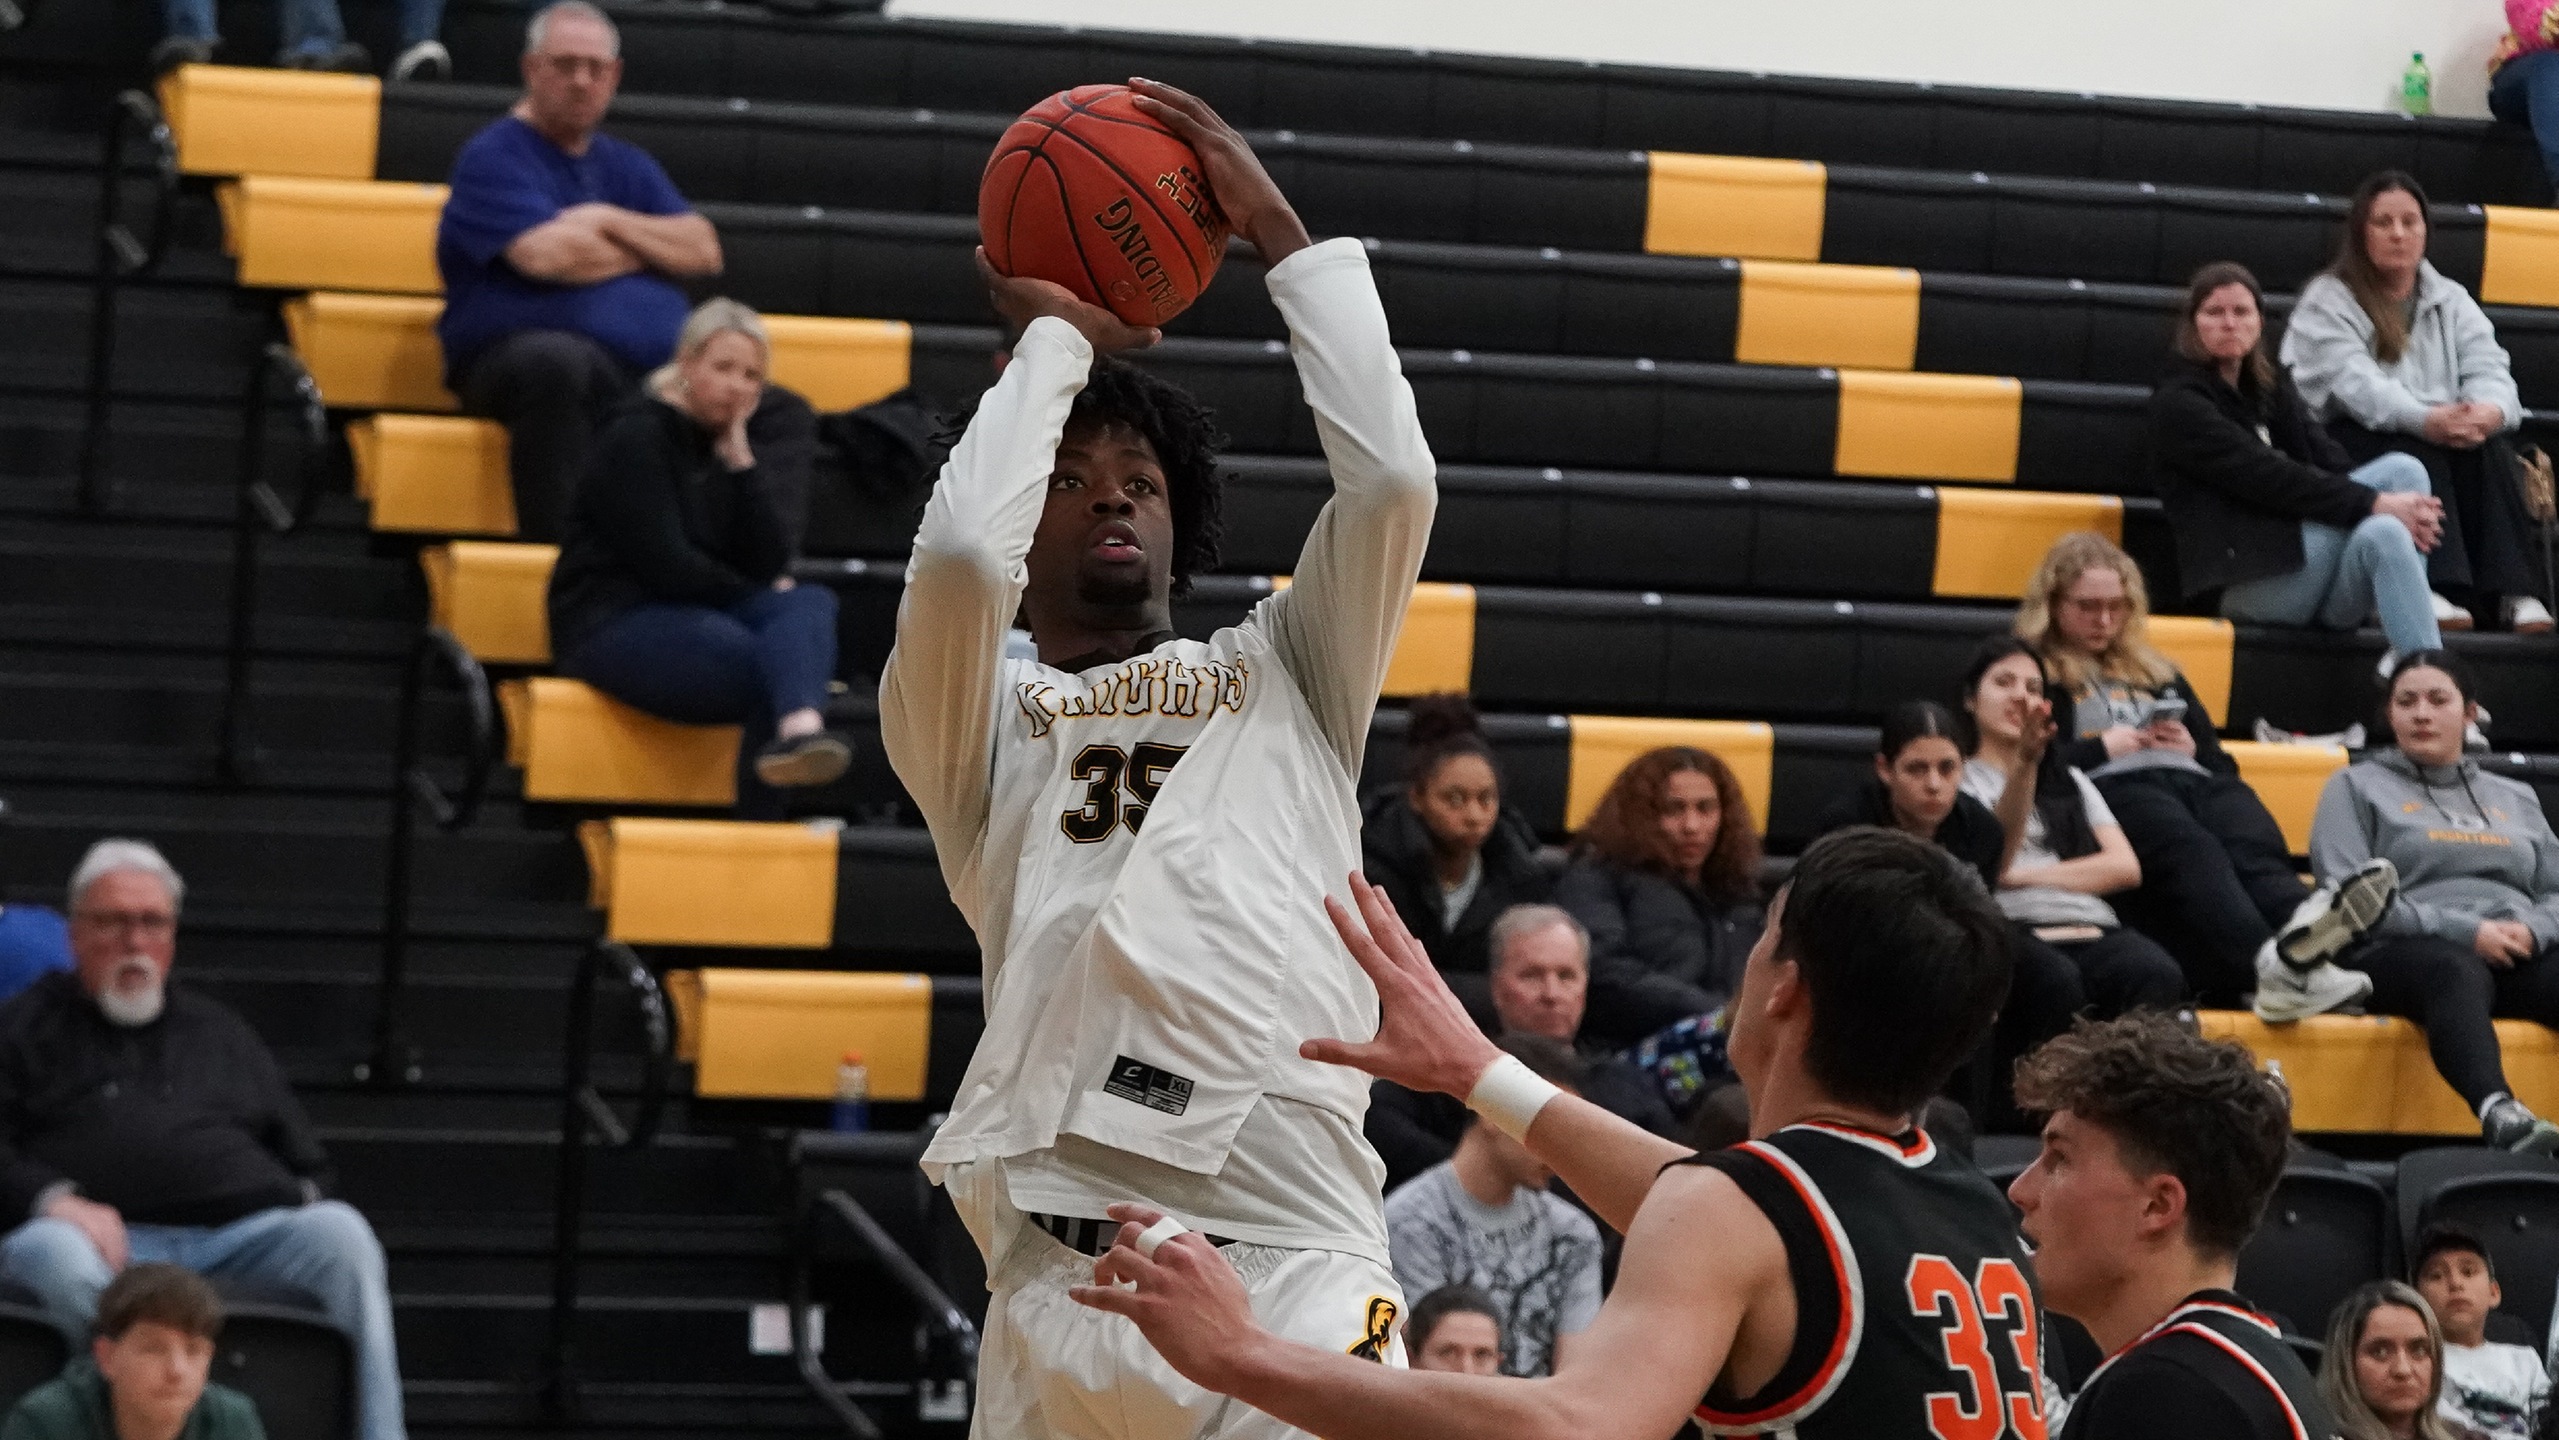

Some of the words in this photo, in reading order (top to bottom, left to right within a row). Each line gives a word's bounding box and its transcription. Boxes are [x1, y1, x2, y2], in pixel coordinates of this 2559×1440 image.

[1094, 196, 1188, 319] PALDING
[1061, 742, 1191, 844] 35
[1171, 1079, 1188, 1094] XL
[1905, 1253, 2049, 1440] 33
